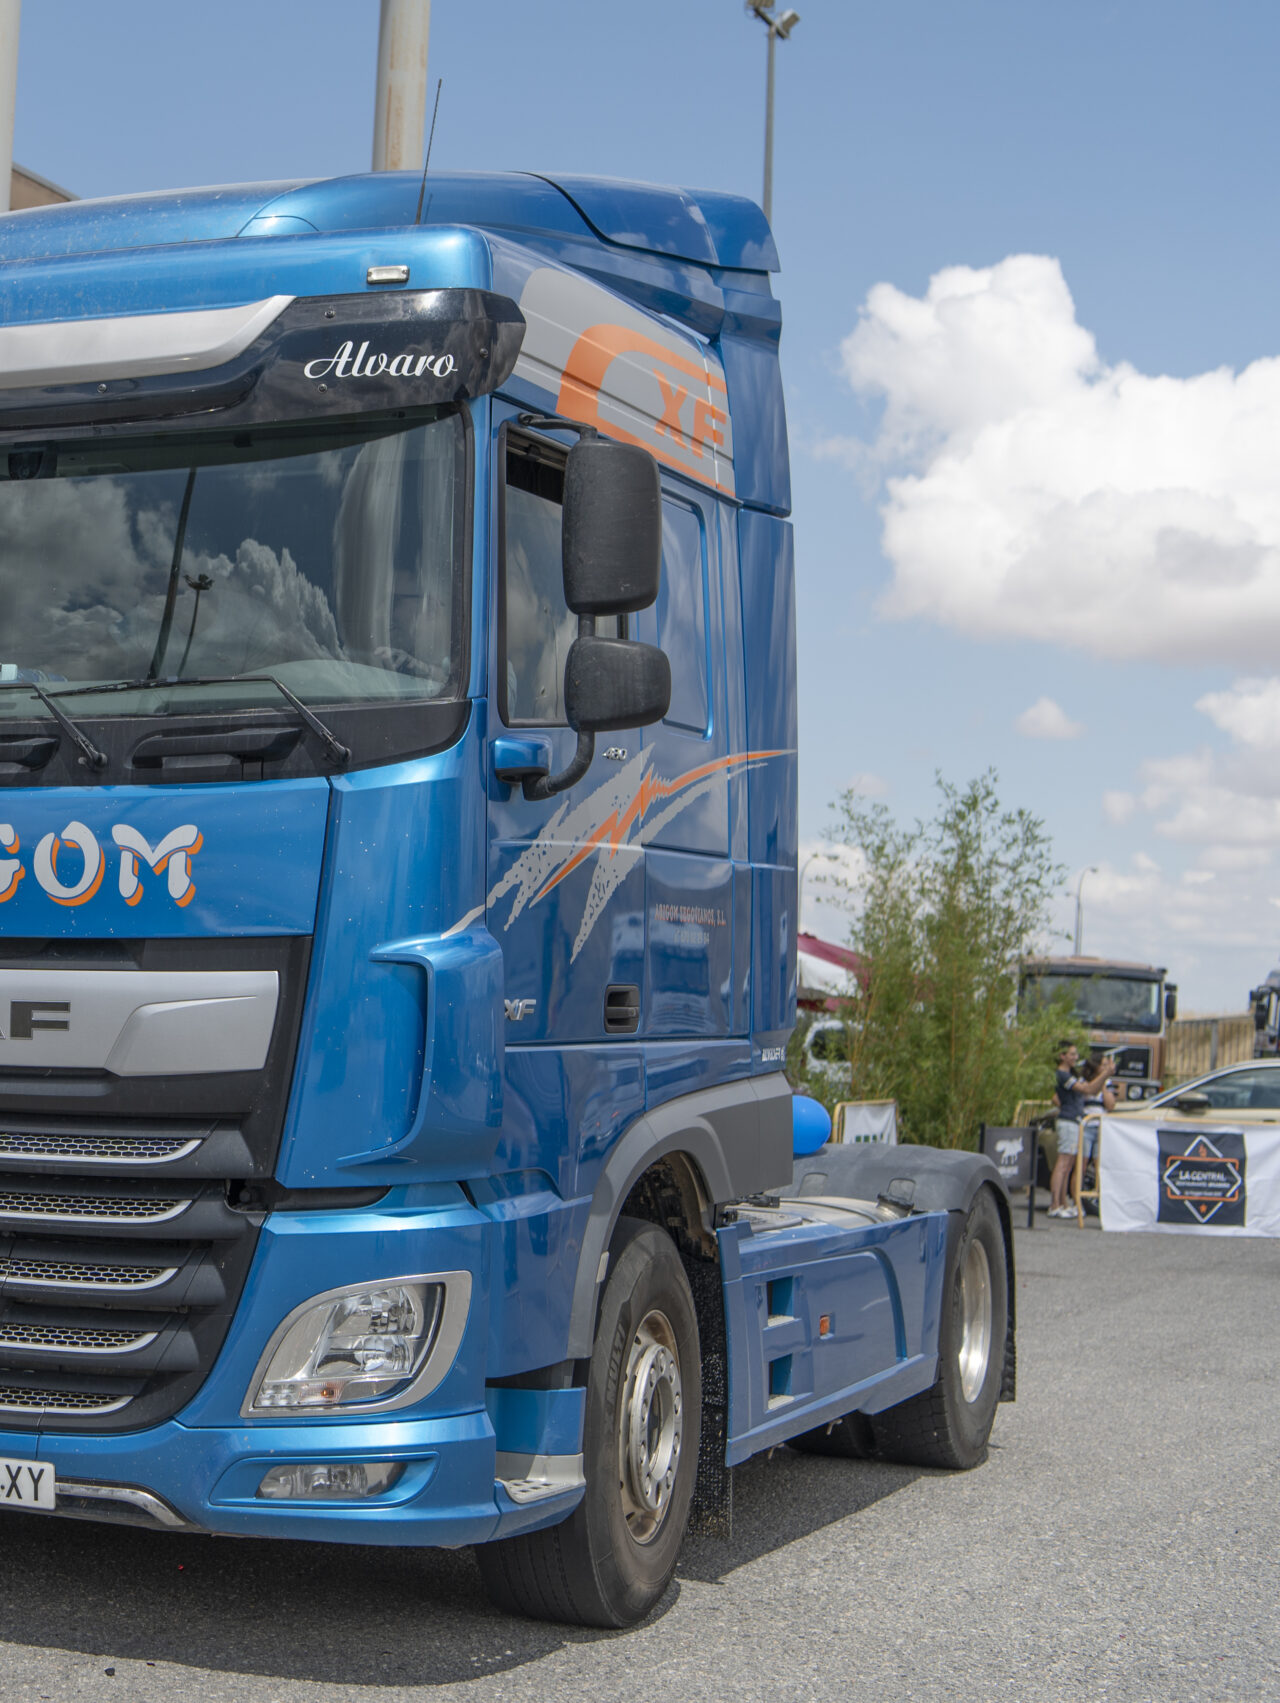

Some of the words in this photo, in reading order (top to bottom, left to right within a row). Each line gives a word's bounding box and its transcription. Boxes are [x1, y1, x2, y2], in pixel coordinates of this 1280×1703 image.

[304, 341, 458, 379] Alvaro
[653, 368, 727, 459] XF
[504, 999, 537, 1021] XF
